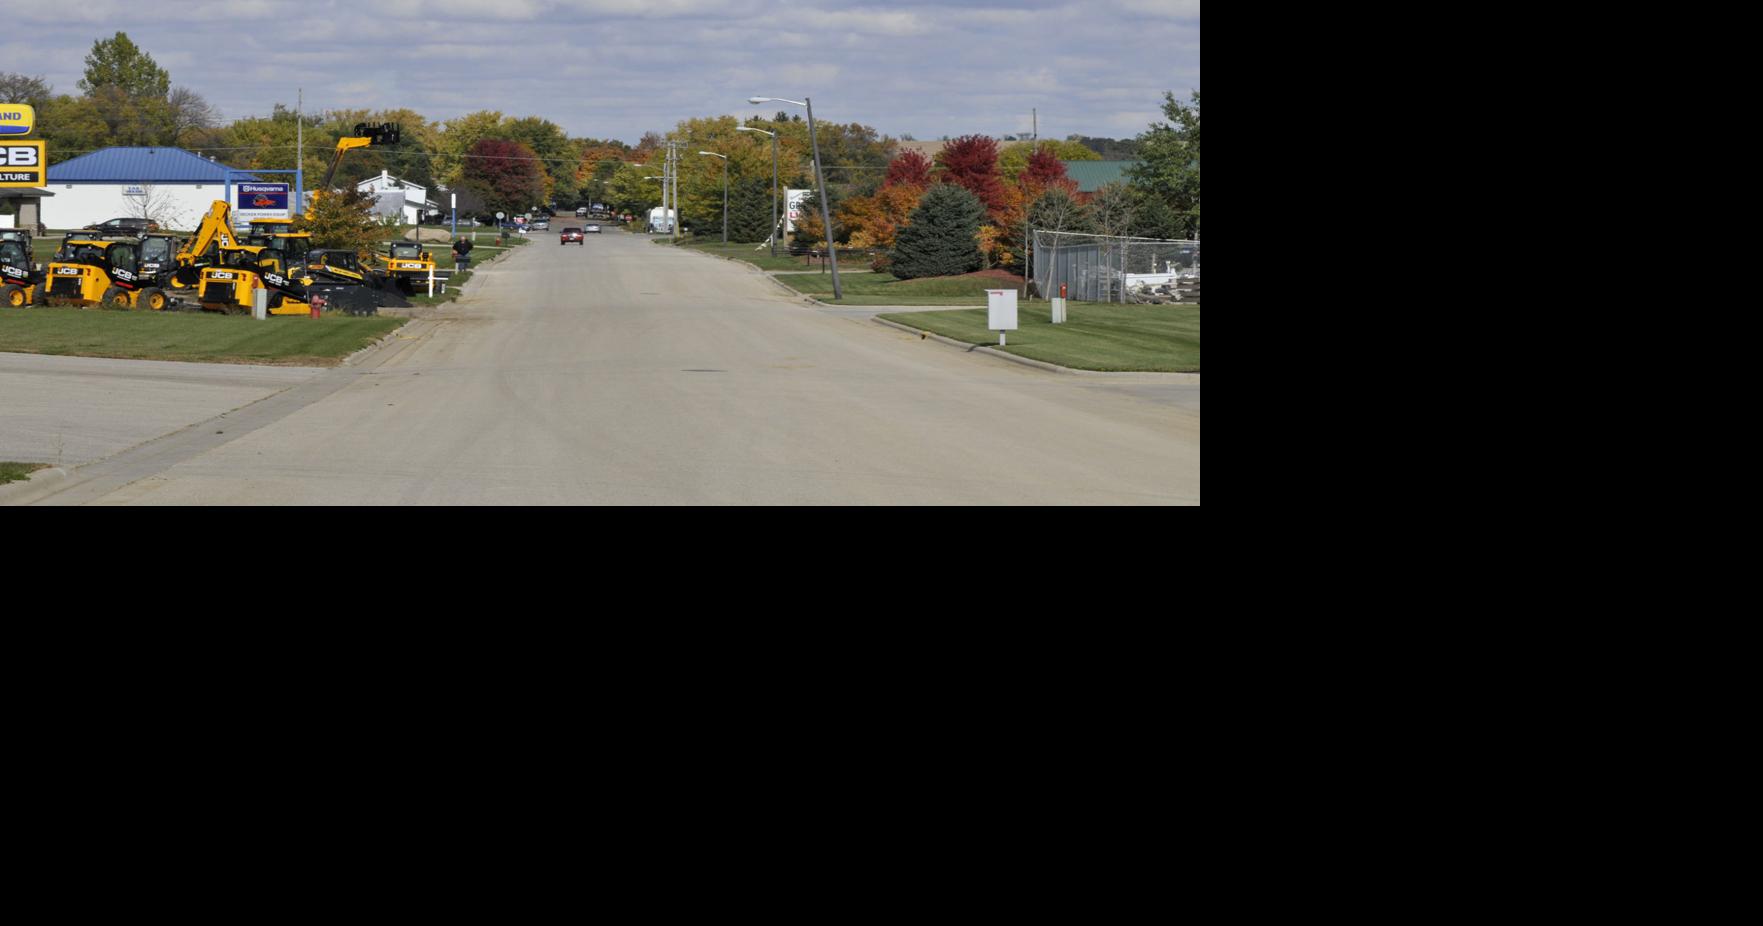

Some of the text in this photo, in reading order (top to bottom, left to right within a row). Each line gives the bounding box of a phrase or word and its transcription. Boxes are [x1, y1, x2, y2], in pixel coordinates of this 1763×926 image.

[0, 112, 21, 120] ND
[1, 265, 22, 276] JCB
[112, 267, 132, 279] JCB
[264, 272, 283, 284] JCB
